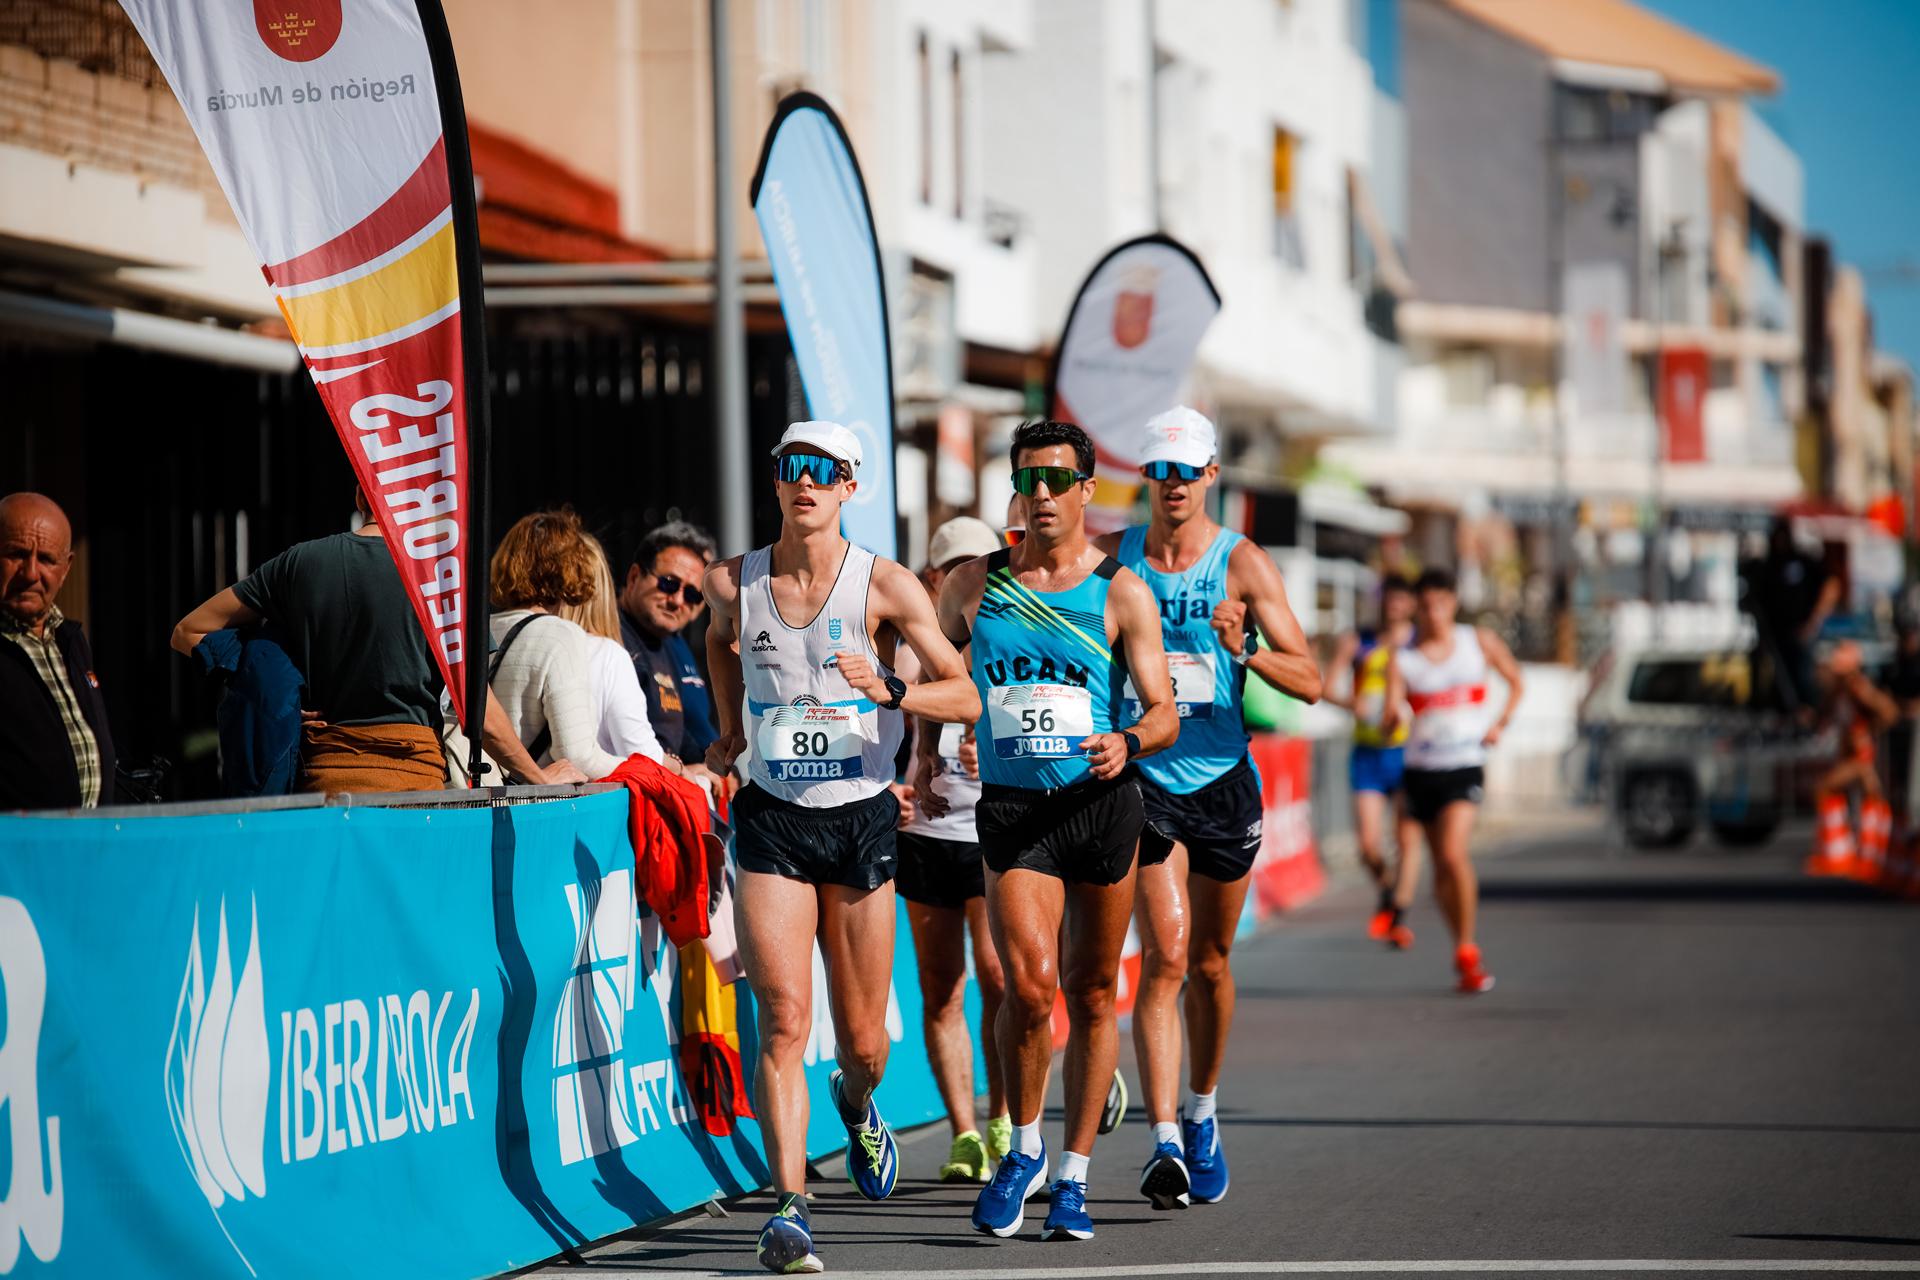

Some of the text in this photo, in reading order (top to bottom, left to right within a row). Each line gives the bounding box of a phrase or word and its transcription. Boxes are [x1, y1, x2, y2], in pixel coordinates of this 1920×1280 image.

[1159, 591, 1211, 627] rja
[984, 656, 1090, 688] UCAM
[1021, 708, 1056, 733] 56
[791, 731, 830, 757] 80
